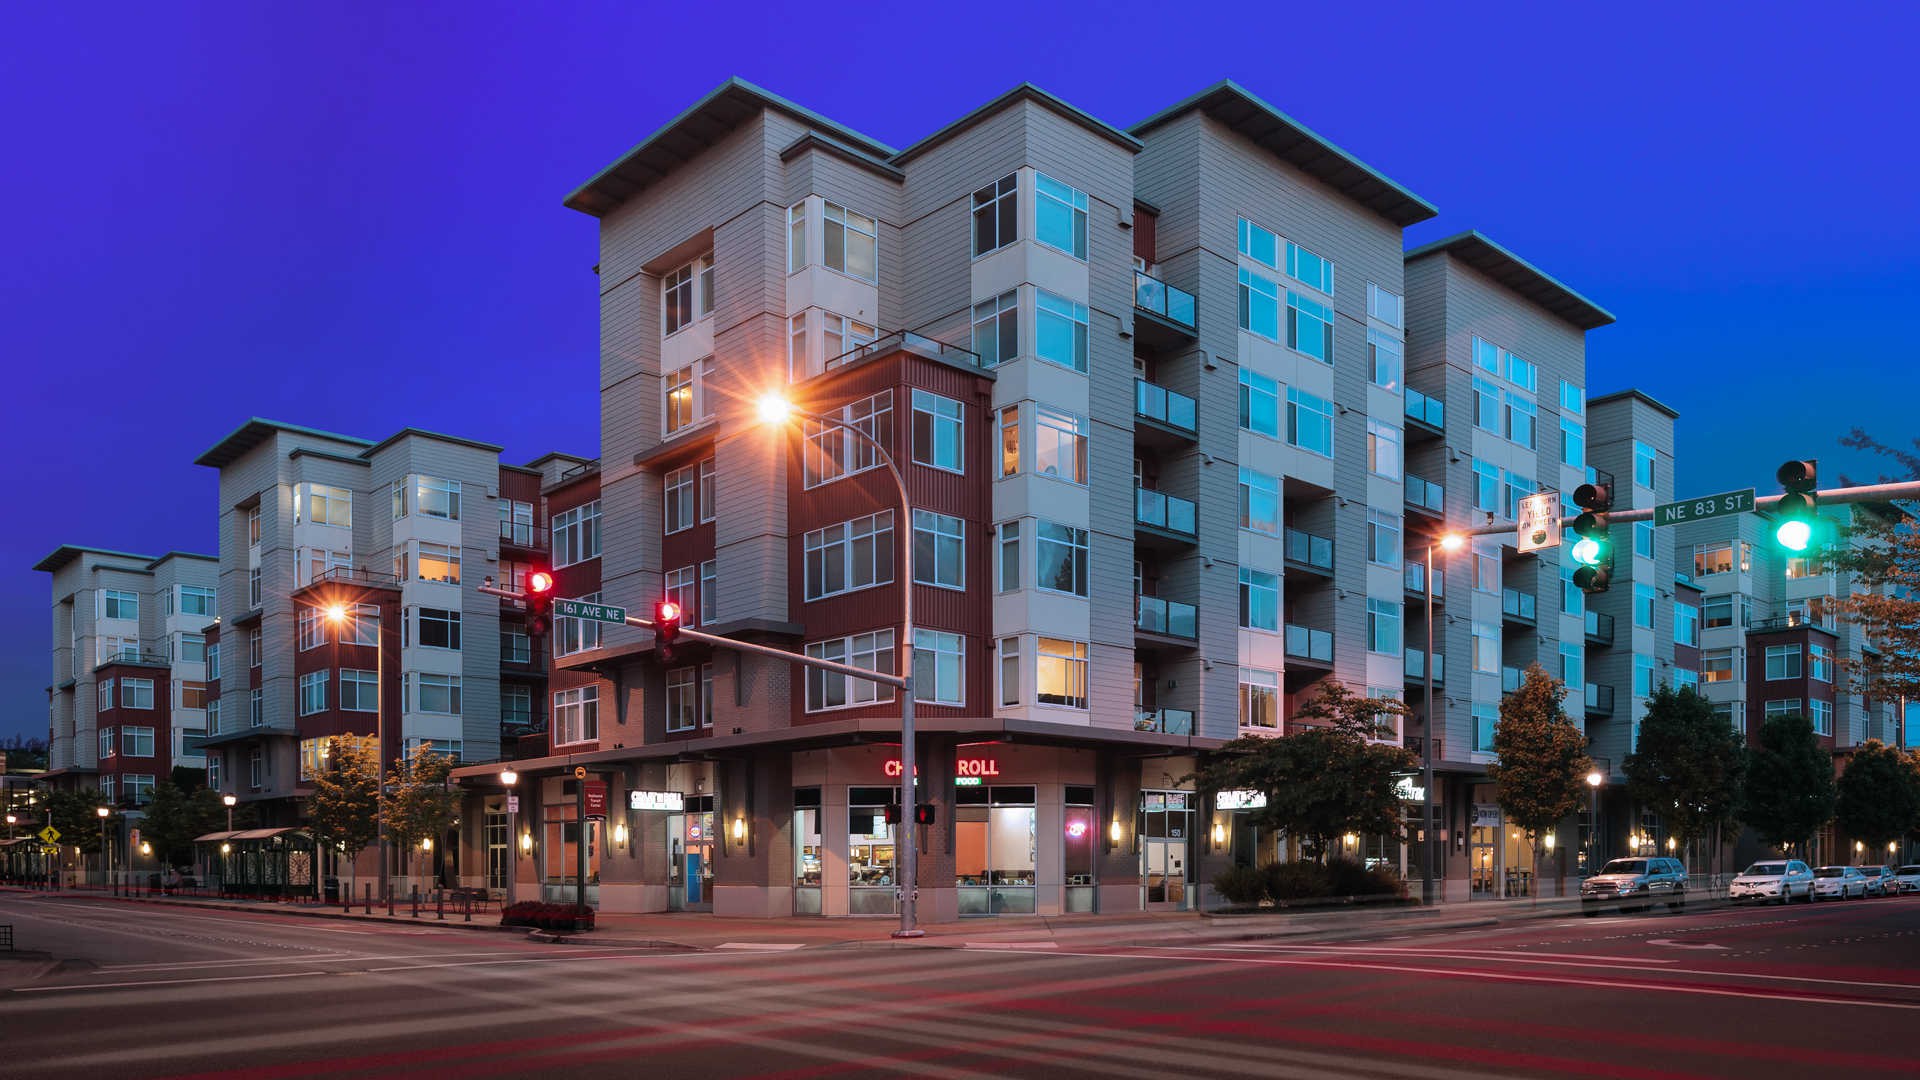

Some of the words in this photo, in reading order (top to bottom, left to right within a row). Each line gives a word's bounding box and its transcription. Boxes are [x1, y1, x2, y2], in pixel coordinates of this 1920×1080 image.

[1666, 506, 1686, 521] NE
[1695, 500, 1716, 516] 83
[1725, 494, 1744, 511] ST
[563, 602, 577, 614] 161
[582, 605, 601, 618] AVE
[606, 608, 620, 620] NE
[958, 759, 1000, 776] ROLL
[956, 777, 979, 786] FOOD
